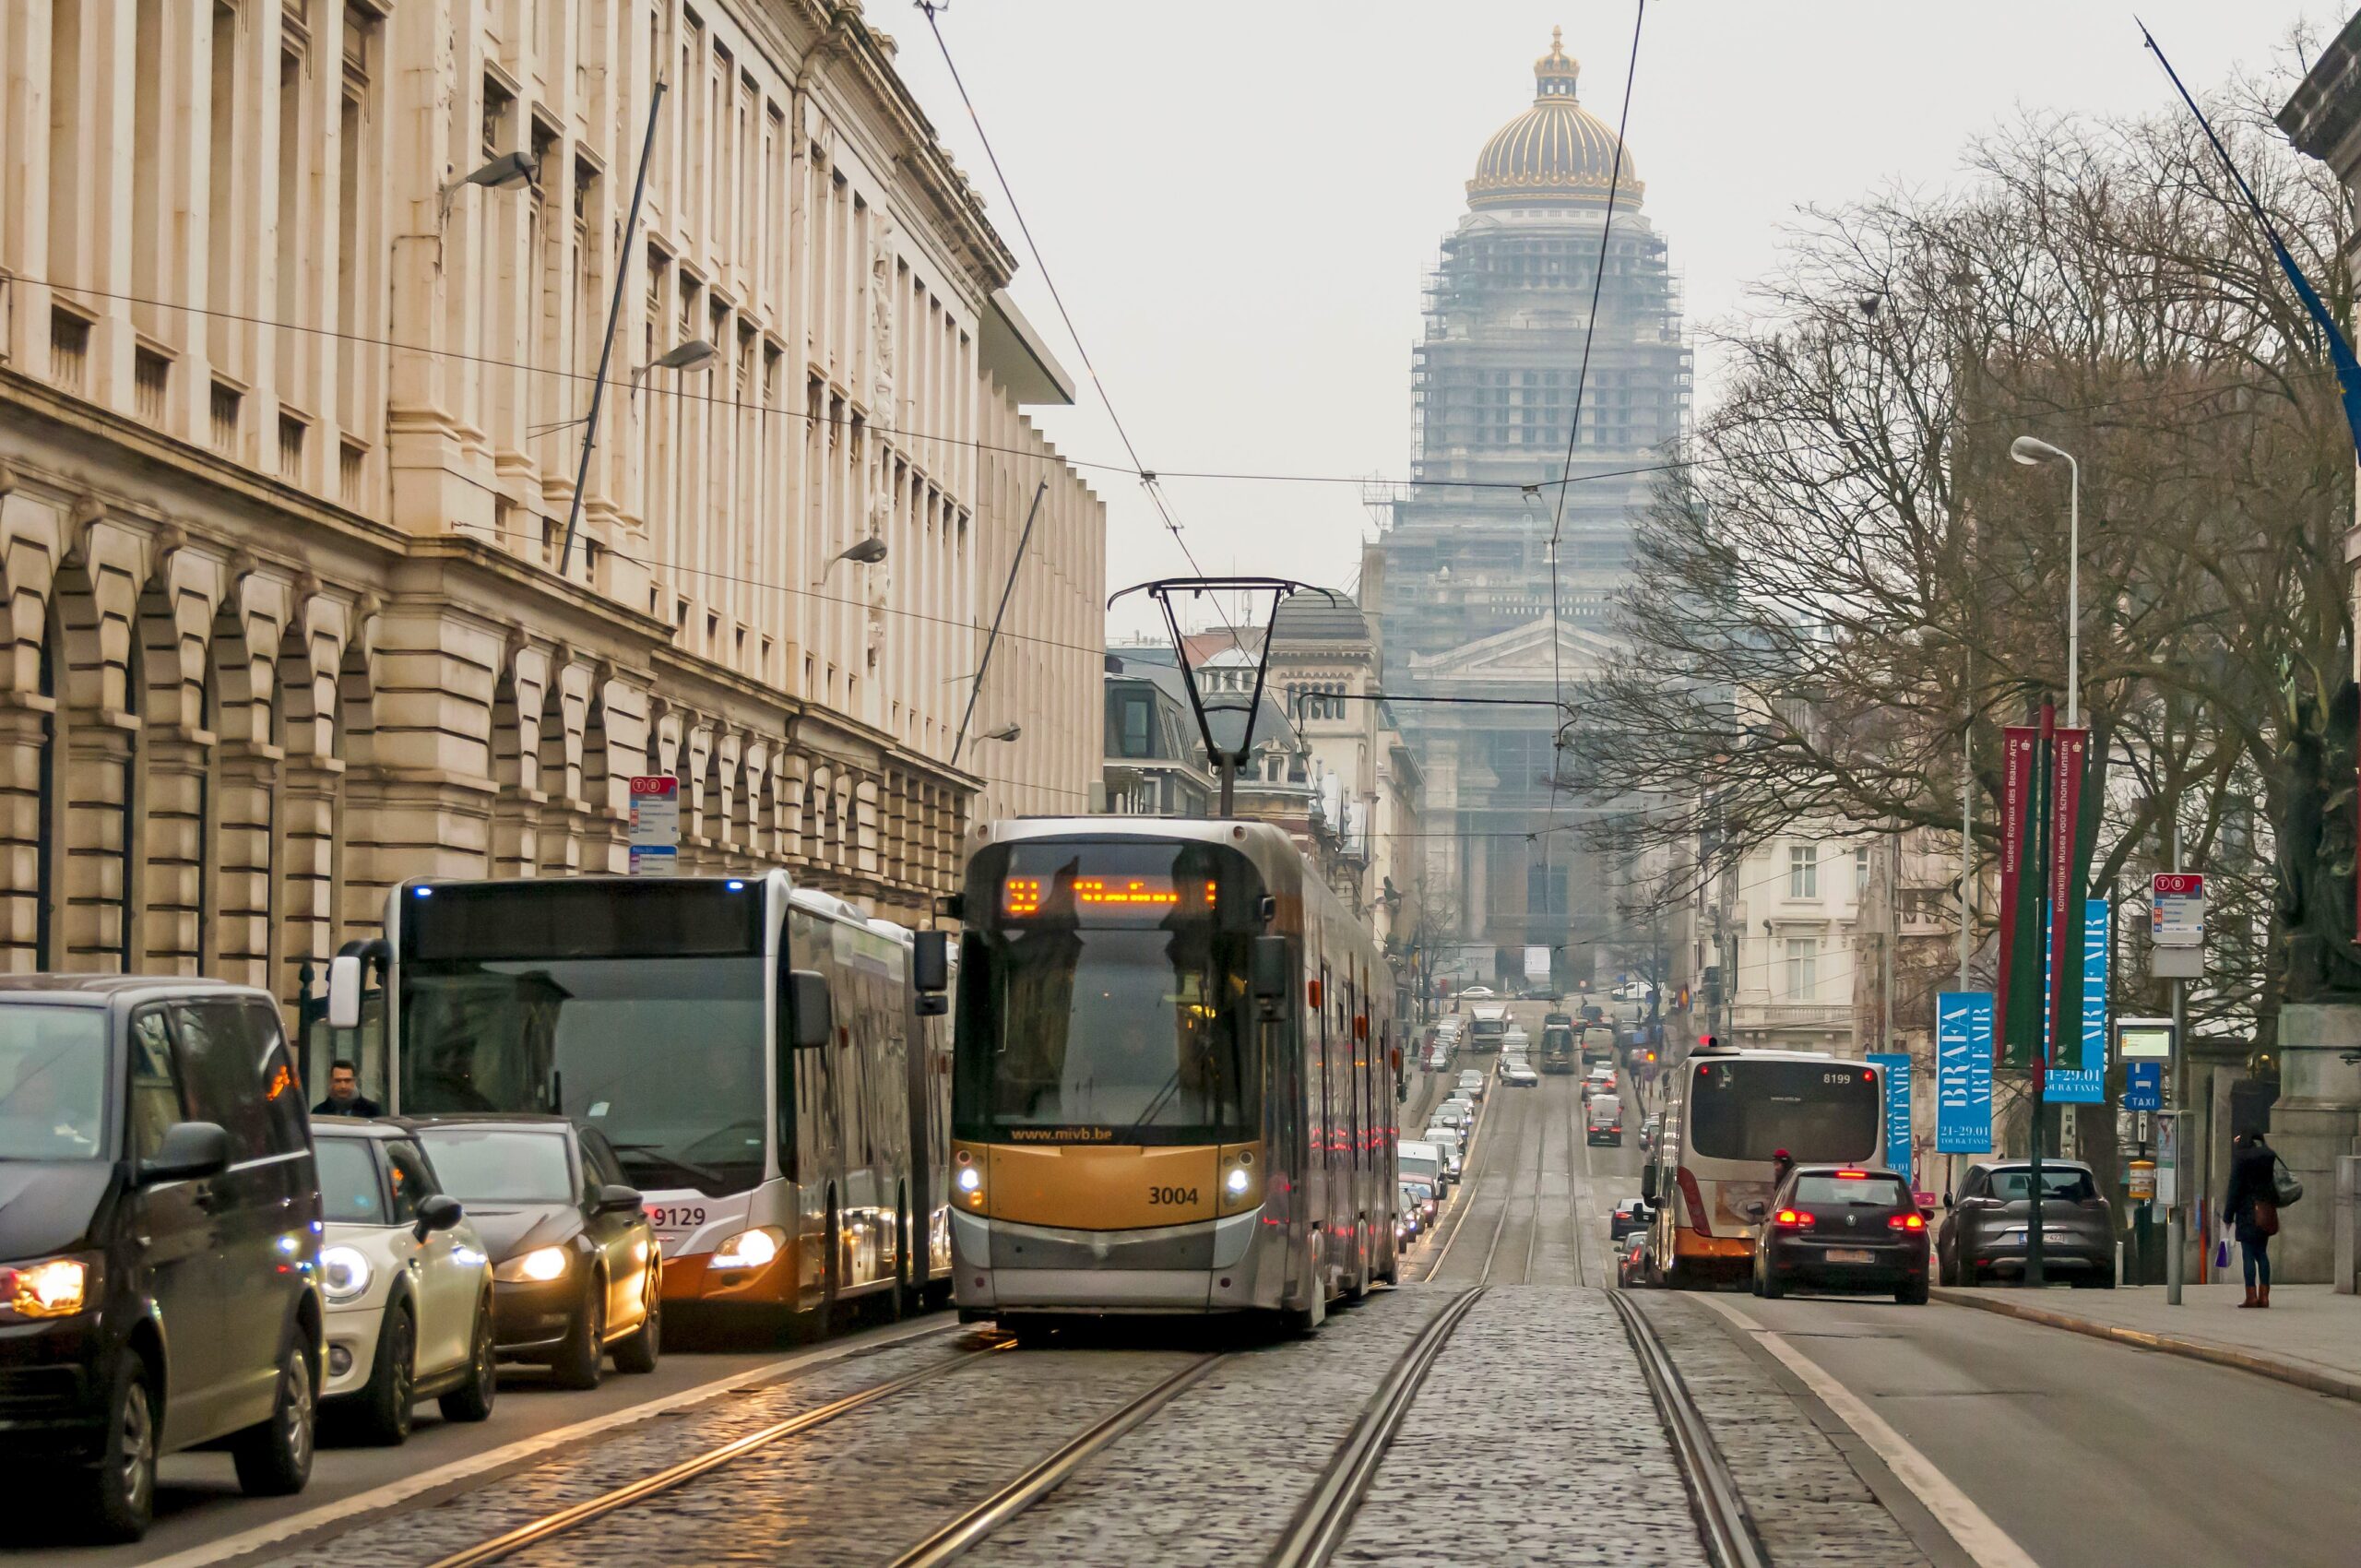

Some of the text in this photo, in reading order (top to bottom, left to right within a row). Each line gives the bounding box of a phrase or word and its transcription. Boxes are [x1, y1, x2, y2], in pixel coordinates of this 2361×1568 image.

[2060, 741, 2069, 777] Kunsten
[2059, 778, 2068, 811] Schone
[2006, 840, 2014, 873] Musées
[2057, 865, 2066, 912] Koninklijke
[1941, 1004, 1970, 1108] BRAFA
[1972, 1007, 1991, 1105] ART FAIR
[1823, 1074, 1851, 1085] 8199
[2131, 1097, 2155, 1107] TAXI
[1011, 1127, 1112, 1141] www.mivb.be
[1148, 1186, 1199, 1206] 3004
[654, 1206, 706, 1228] 9129
